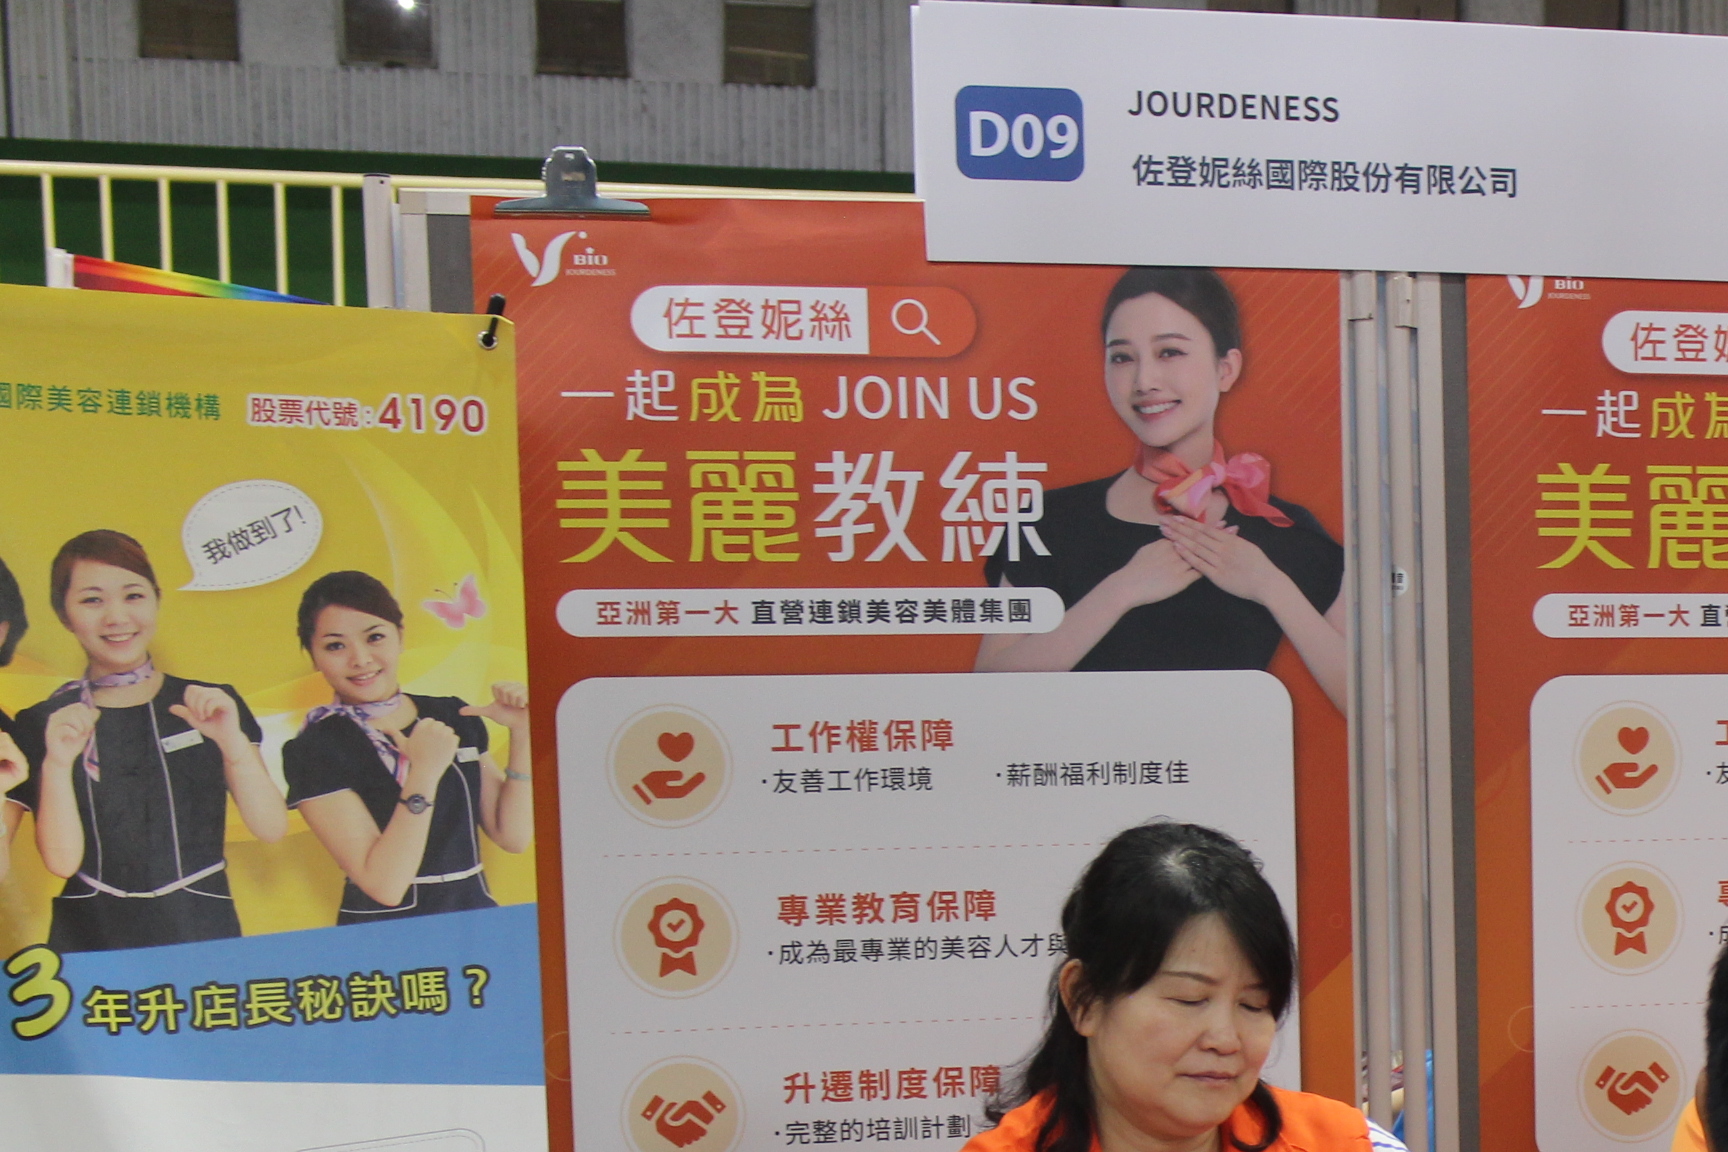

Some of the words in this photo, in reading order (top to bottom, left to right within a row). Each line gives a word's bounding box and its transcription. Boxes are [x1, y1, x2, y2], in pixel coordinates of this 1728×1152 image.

[1128, 90, 1340, 123] JOURDENESS
[970, 109, 1079, 160] D09
[1132, 153, 1519, 198] 佐登妮絲國際股份有限公司
[662, 296, 853, 343] 佐登妮絲
[560, 369, 804, 424] 一起成為
[822, 375, 950, 421] JOIN
[969, 376, 1039, 421] US
[555, 447, 1053, 564] 美麗教練
[201, 505, 308, 566] 我做到了!
[596, 599, 740, 628] 亞洲第一大
[751, 598, 1033, 627] 直營連鎖美容美體集團
[1567, 604, 1691, 629] 亞洲第一大
[771, 717, 956, 755] 工作權保障
[777, 888, 997, 927] 專業教育保障
[783, 1064, 1002, 1104] 升遷制度保障
